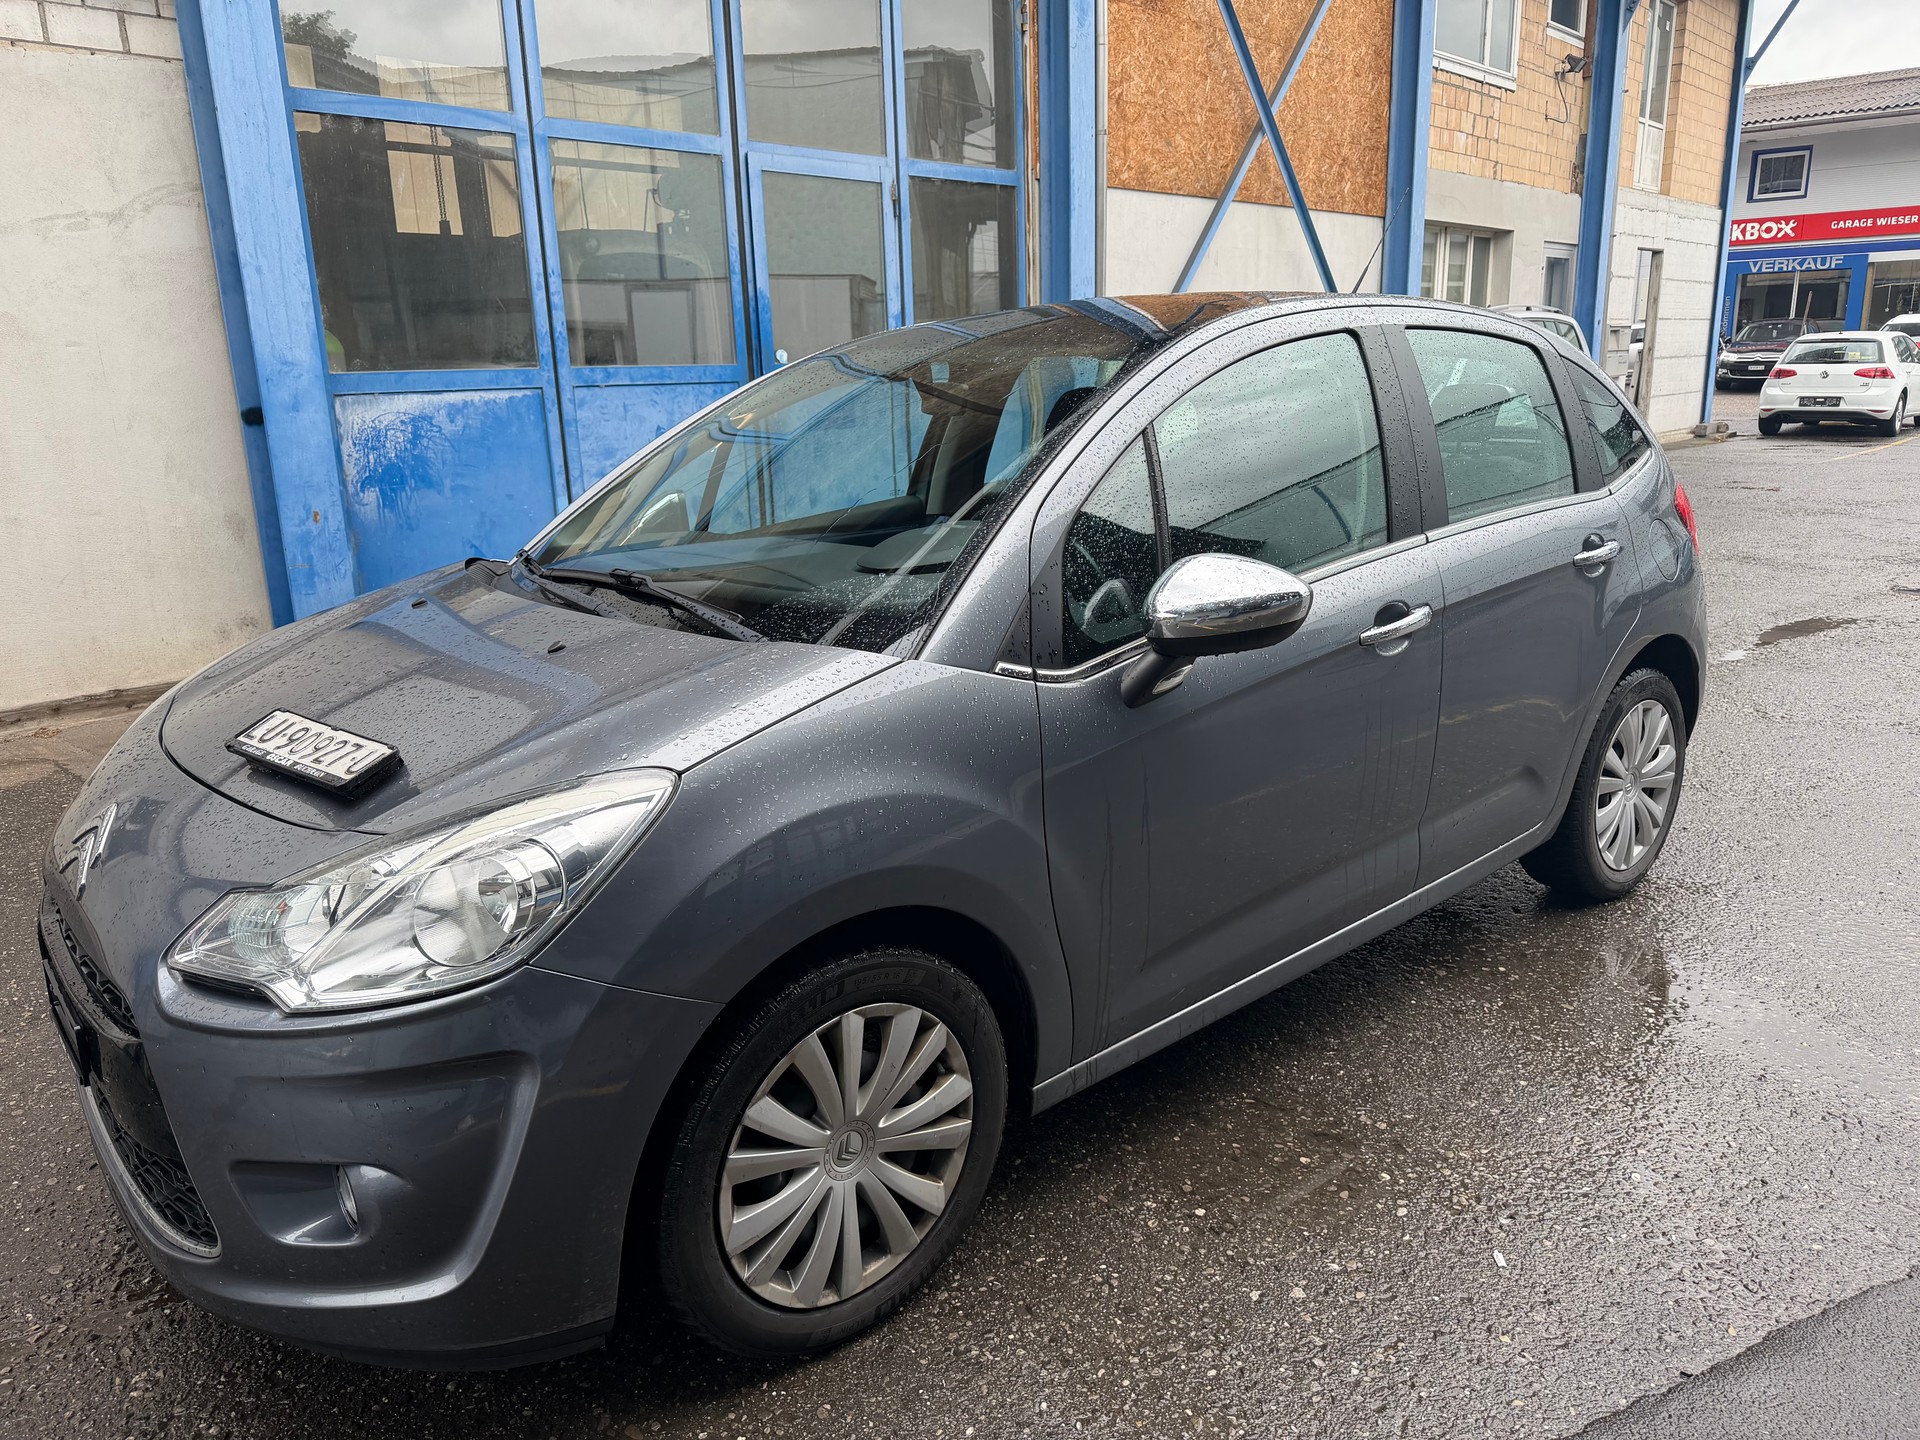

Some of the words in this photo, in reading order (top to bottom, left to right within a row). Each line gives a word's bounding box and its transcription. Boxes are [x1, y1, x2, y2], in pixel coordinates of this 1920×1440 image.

[1831, 218, 1873, 229] GARAGE
[1877, 215, 1919, 226] WIESER
[1730, 219, 1797, 241] KBOX
[1749, 256, 1844, 273] VERKAUF
[266, 753, 294, 767] OSCAR
